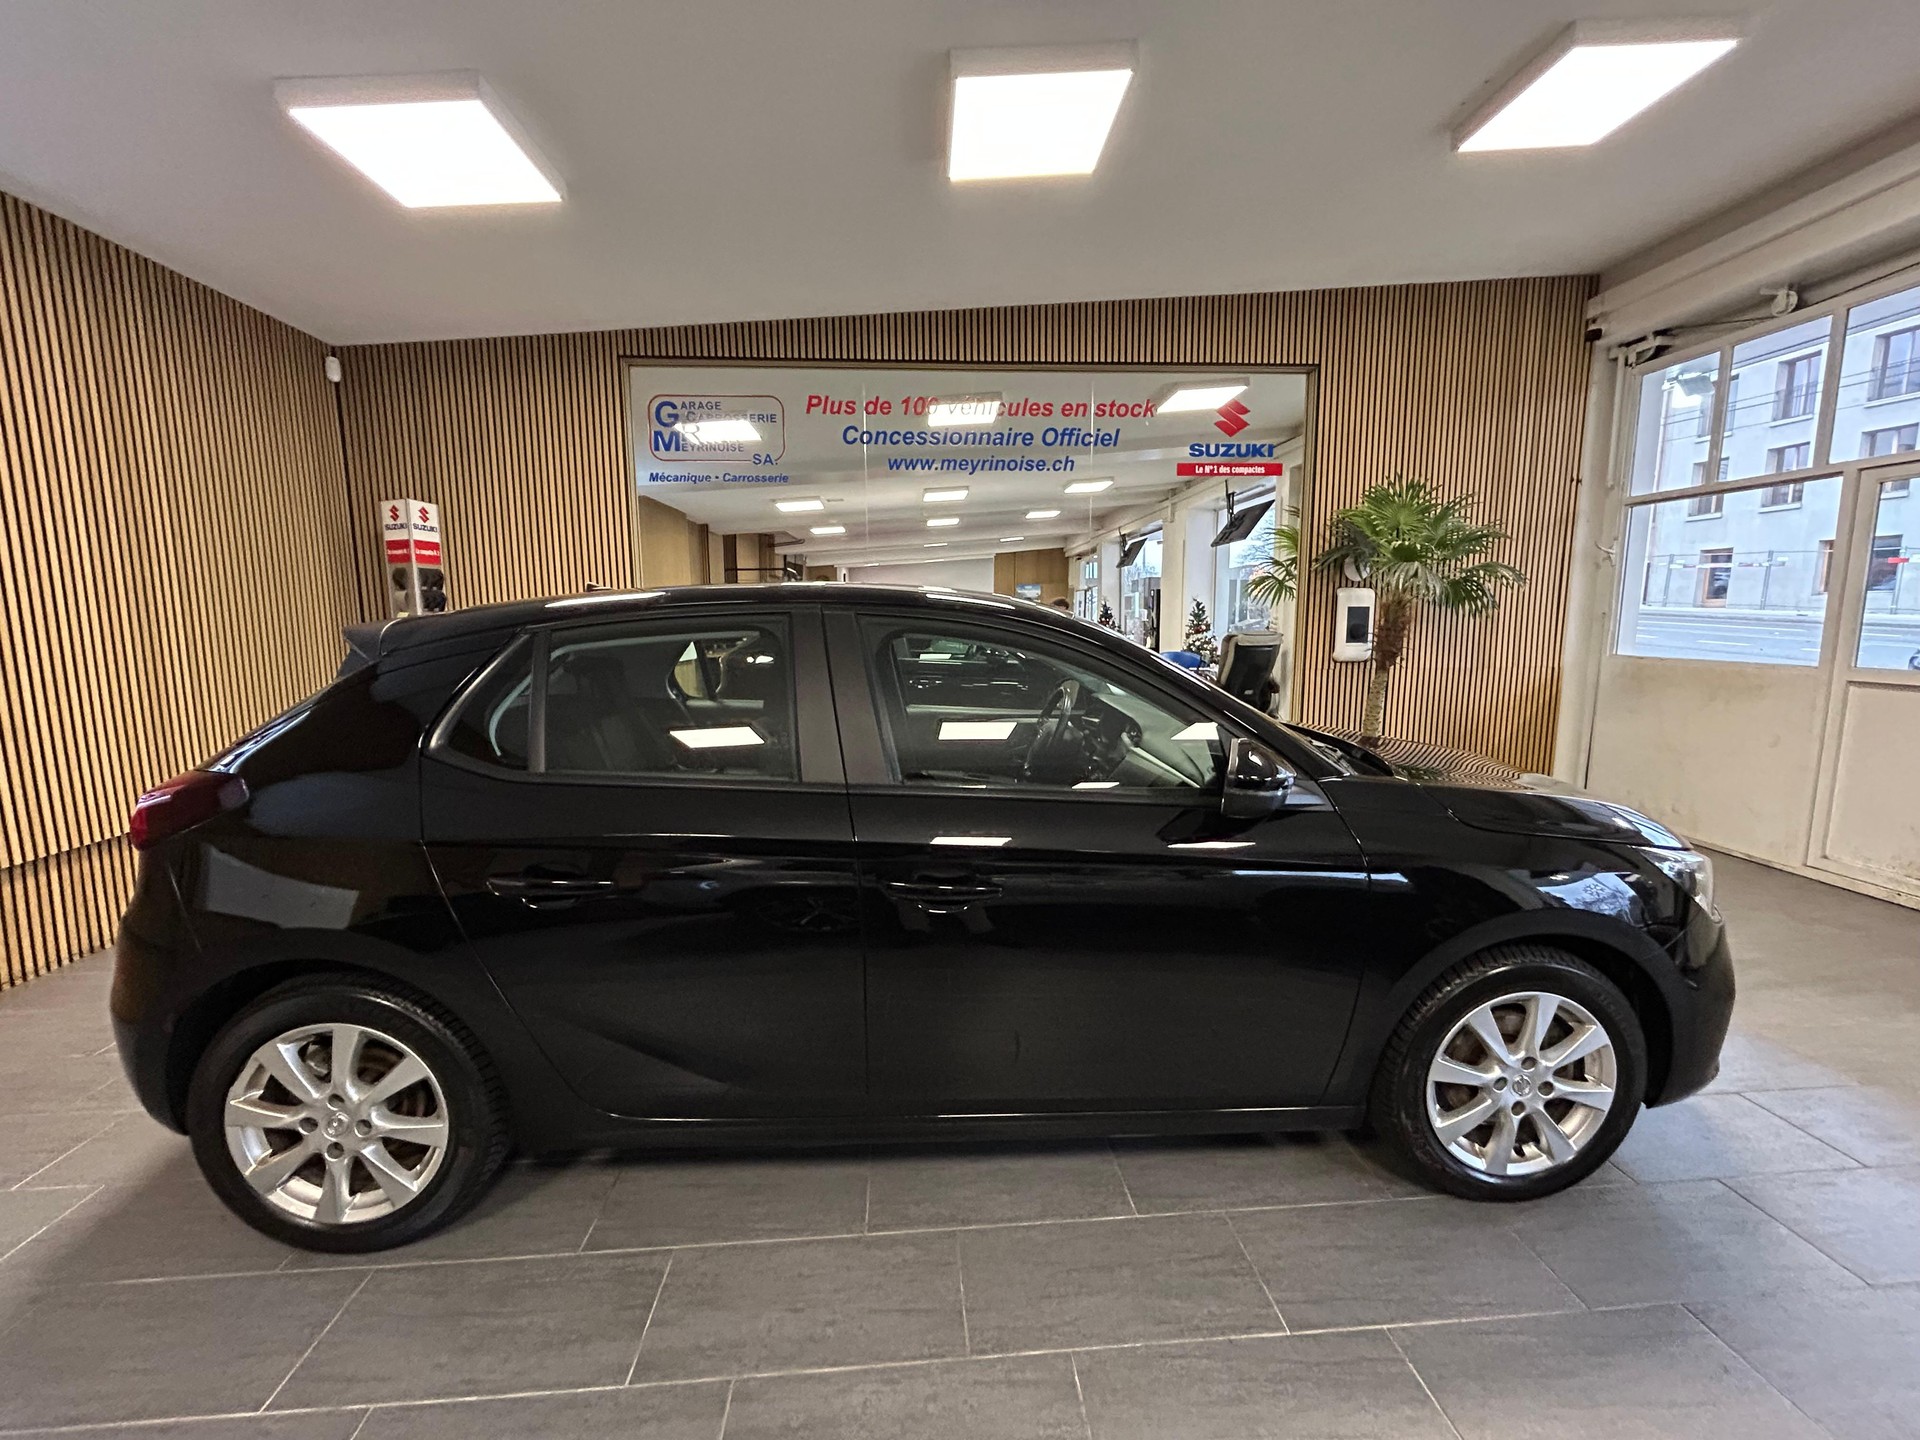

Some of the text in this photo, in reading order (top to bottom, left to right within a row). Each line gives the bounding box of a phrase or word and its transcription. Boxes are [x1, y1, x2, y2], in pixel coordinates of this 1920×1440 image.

[805, 394, 857, 415] Plus
[864, 395, 892, 416] de
[901, 396, 938, 416] 100
[1060, 402, 1088, 418] en
[1094, 398, 1157, 418] stock
[842, 425, 1121, 448] Concessionnaire Officiel
[1188, 442, 1275, 458] SUZUKI
[888, 454, 1075, 476] www.meyrinoise.ch
[1195, 464, 1204, 474] Le
[1218, 464, 1230, 474] des
[1231, 465, 1265, 475] compactes
[648, 472, 789, 485] Mécanique Carrosserie
[384, 523, 408, 531] SUZUKI
[412, 522, 438, 532] SUZUKI
